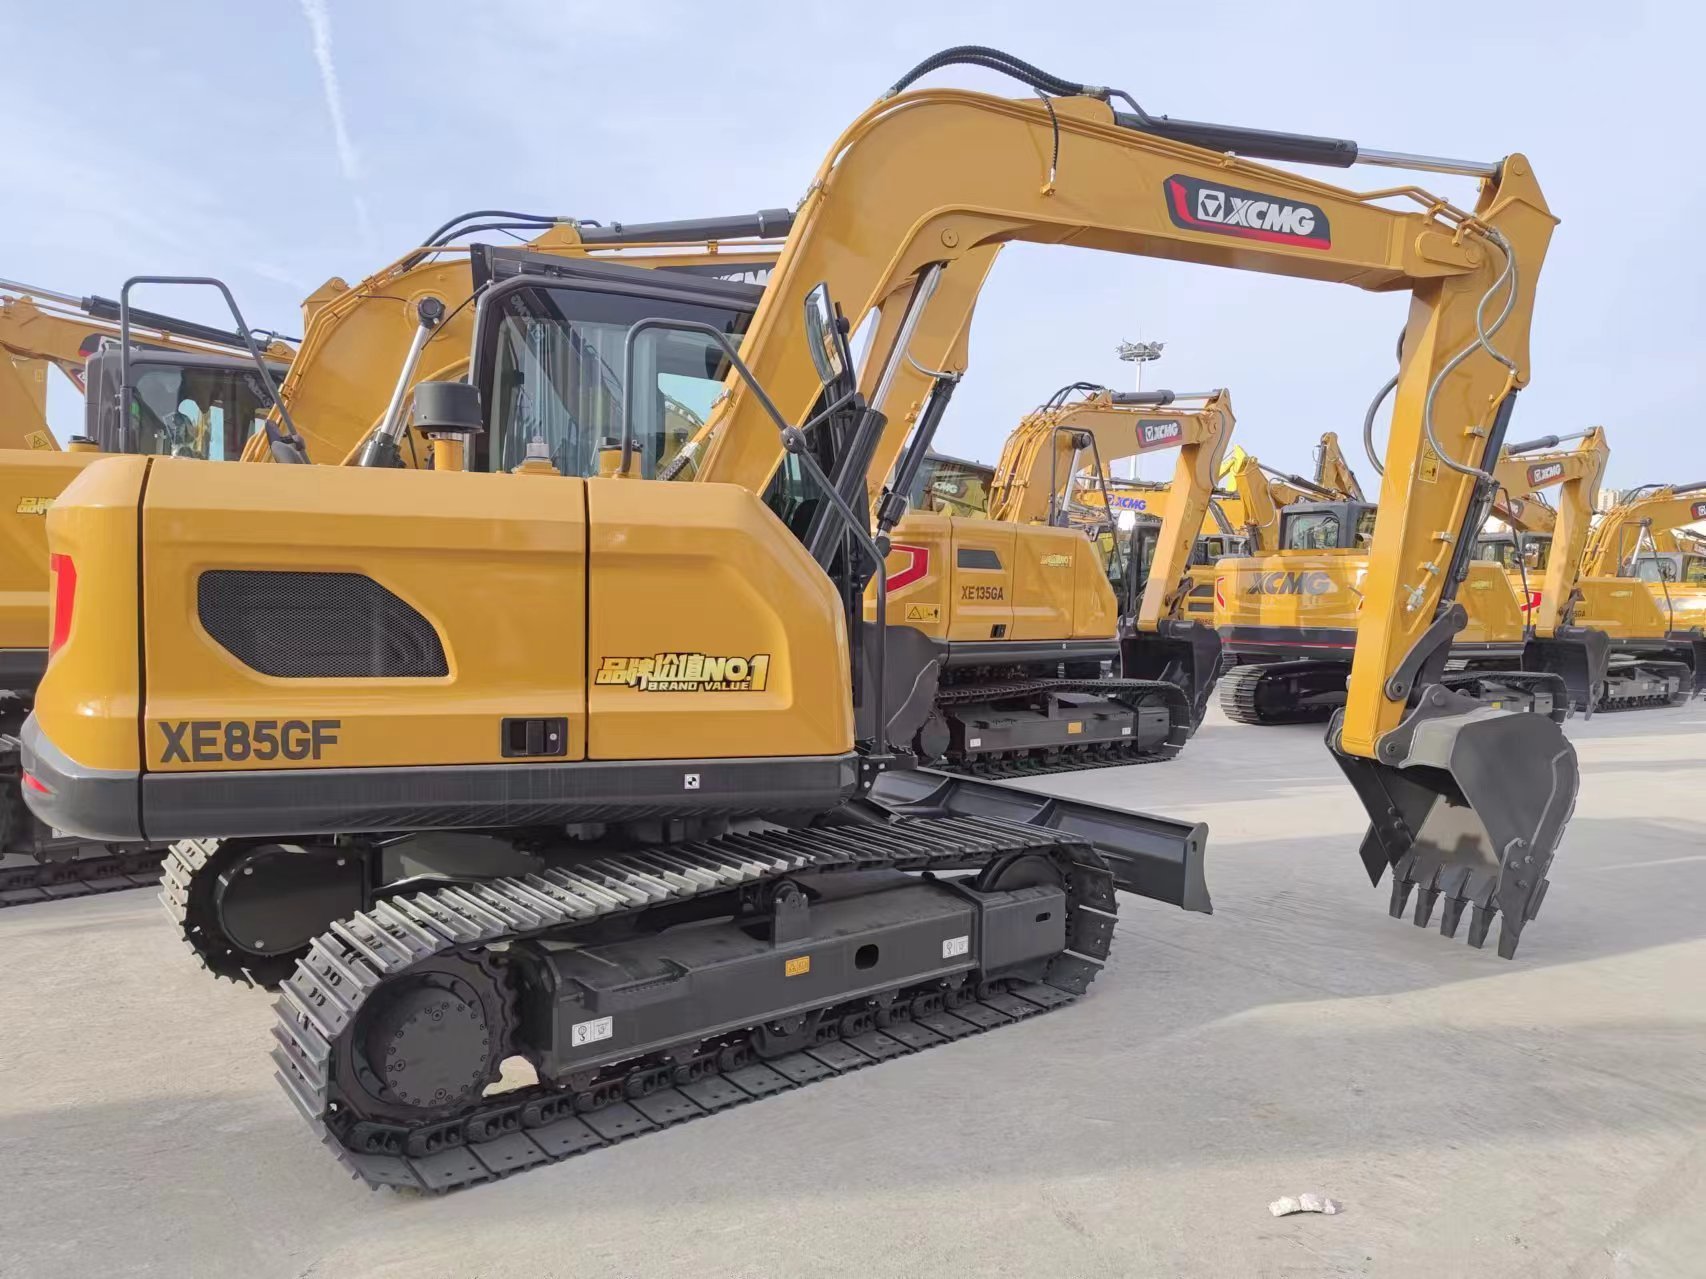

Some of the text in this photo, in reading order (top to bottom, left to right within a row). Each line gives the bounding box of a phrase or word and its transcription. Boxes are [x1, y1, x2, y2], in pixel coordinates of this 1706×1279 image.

[1223, 197, 1315, 235] XCMG
[1153, 422, 1179, 440] XCMG
[1541, 464, 1561, 479] XCMG
[1115, 496, 1147, 511] XCMG
[1248, 571, 1331, 595] XCMG
[961, 585, 1004, 600] XE135GA
[648, 681, 750, 691] BRAND VALUE
[157, 719, 341, 763] XE85GF
